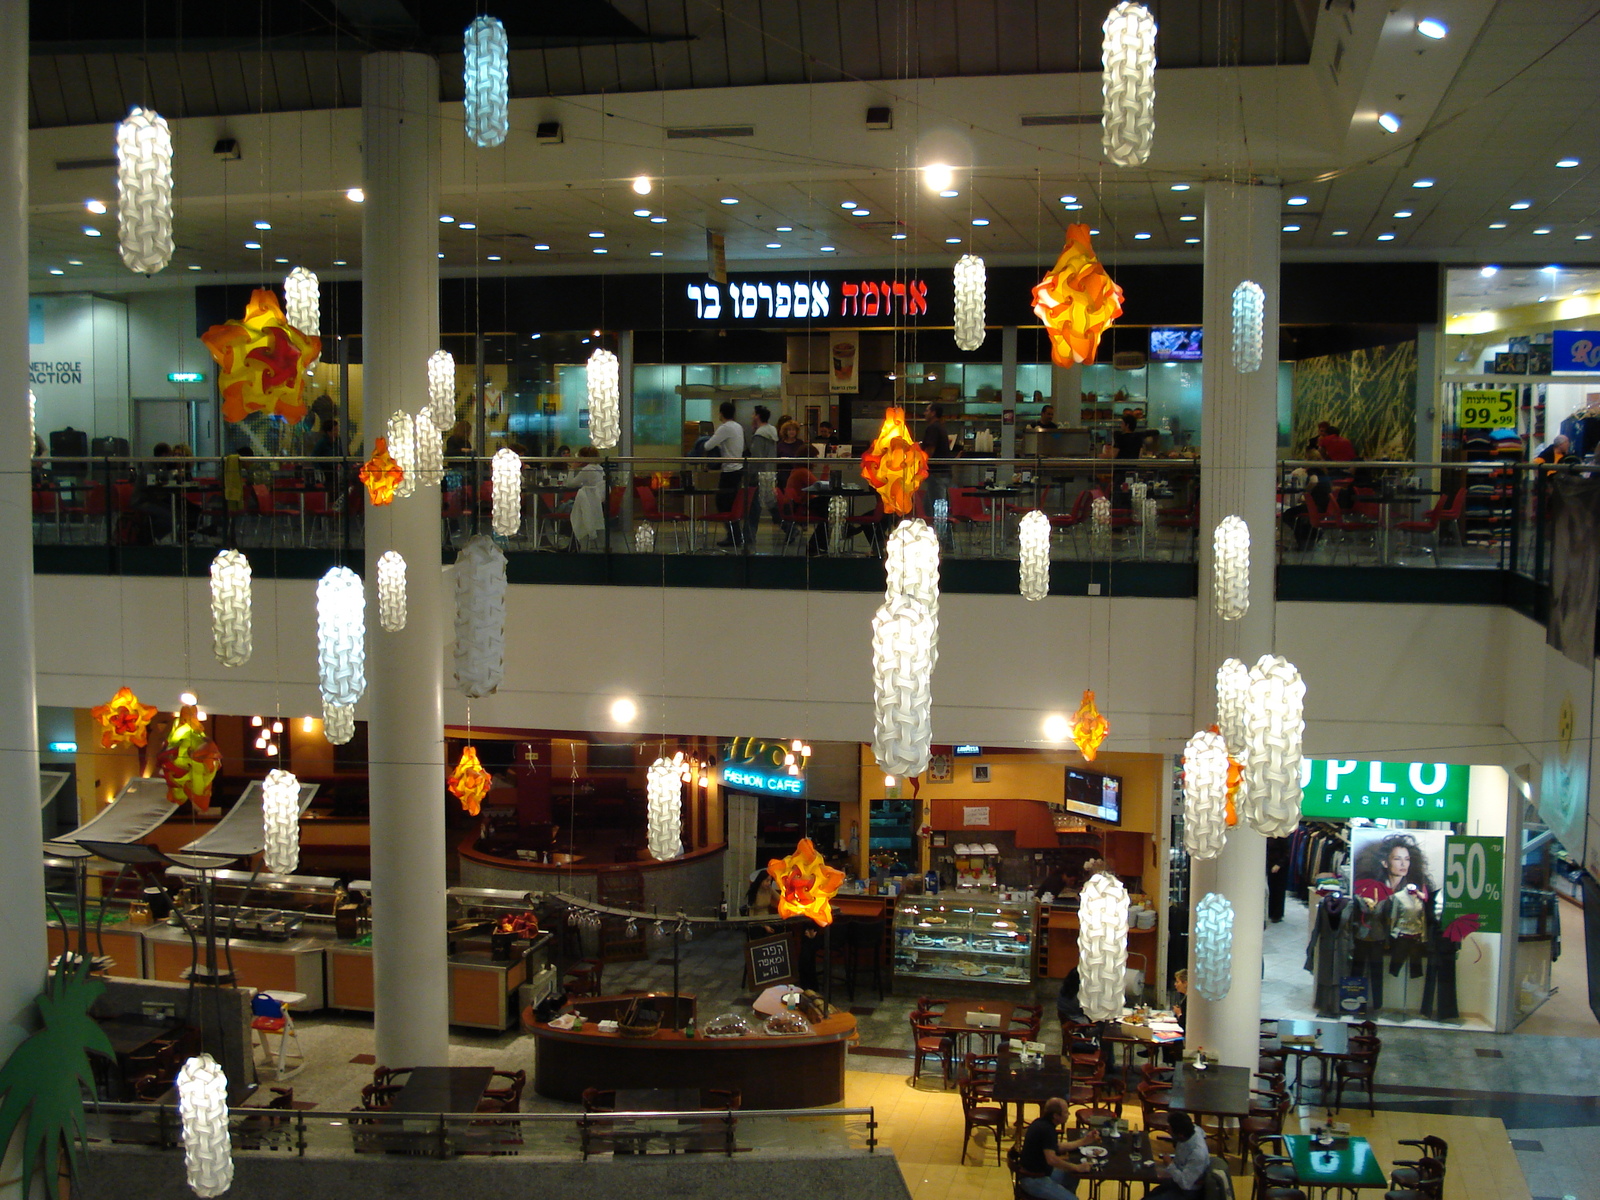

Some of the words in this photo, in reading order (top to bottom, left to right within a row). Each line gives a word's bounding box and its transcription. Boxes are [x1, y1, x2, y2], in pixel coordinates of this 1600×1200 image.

[687, 282, 721, 319] בר
[729, 280, 830, 318] אספרסו
[841, 280, 927, 316] ארומה
[56, 361, 81, 372] COLE
[29, 372, 82, 384] ACTION
[1466, 394, 1497, 404] חולצות
[1499, 392, 1512, 412] 5
[724, 768, 764, 789] FASHION
[767, 778, 801, 793] CAFE
[1326, 794, 1444, 808] FASHION
[762, 945, 783, 956] קפה
[758, 956, 785, 967] ומאפה
